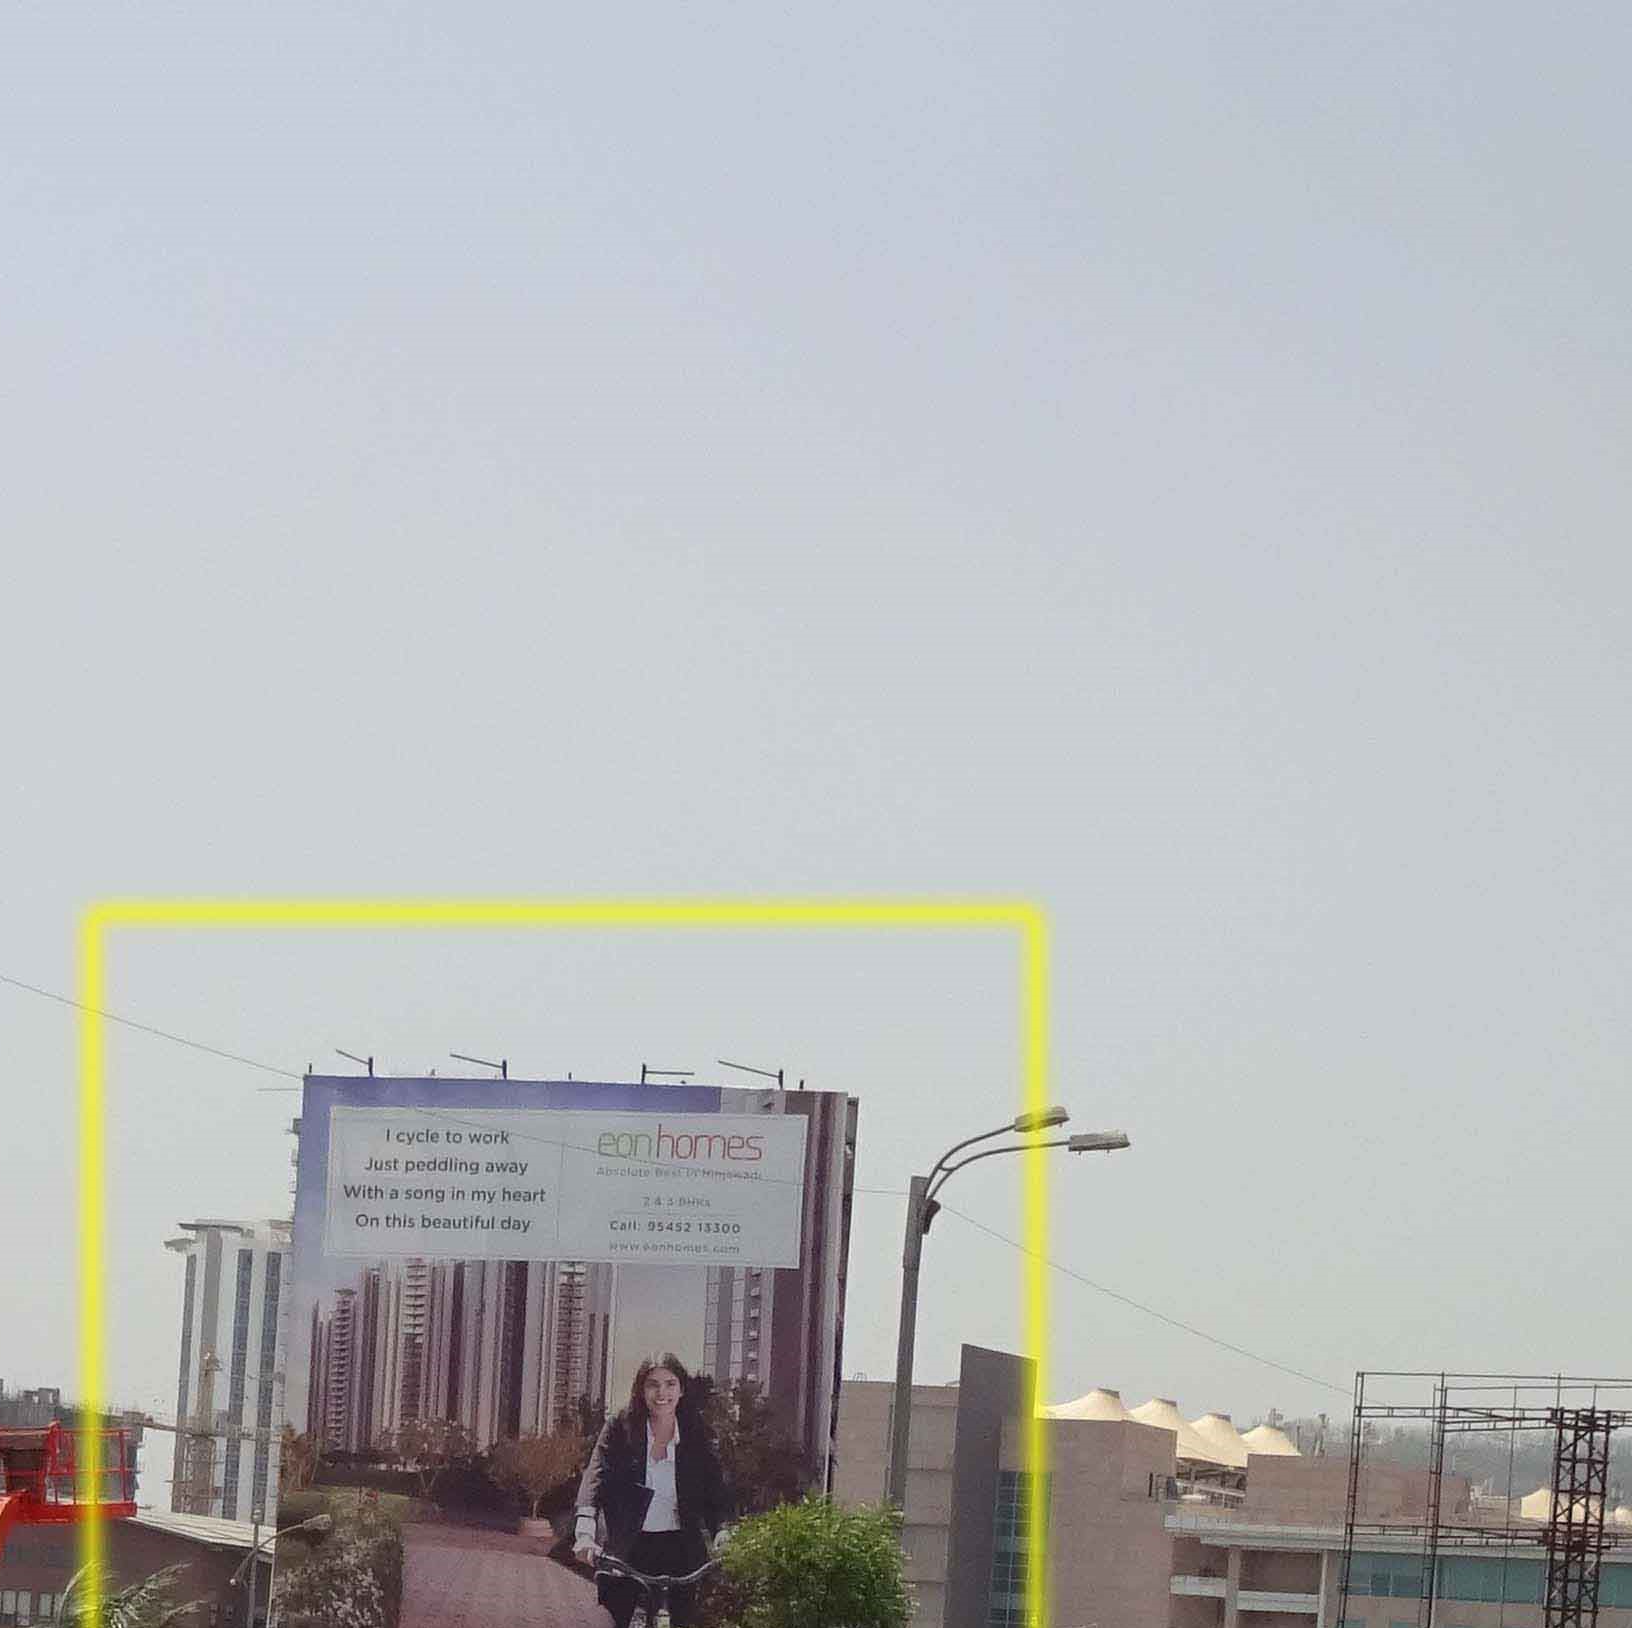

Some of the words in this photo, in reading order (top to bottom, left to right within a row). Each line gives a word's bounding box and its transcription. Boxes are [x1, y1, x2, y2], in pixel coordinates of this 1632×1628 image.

[395, 1128, 440, 1146] cycle
[445, 1129, 463, 1144] to
[468, 1130, 510, 1145] work
[364, 1157, 399, 1172] Just
[404, 1157, 480, 1176] peddling
[484, 1161, 529, 1177] away
[343, 1184, 384, 1200] With
[389, 1187, 399, 1200] a
[404, 1187, 445, 1203] song
[451, 1186, 465, 1201] in
[471, 1188, 496, 1204] my
[502, 1187, 547, 1203] heart
[355, 1213, 380, 1229] On
[385, 1213, 415, 1230] this
[421, 1213, 495, 1231] beautiful
[500, 1216, 531, 1234] day
[609, 1220, 641, 1232] Call:
[647, 1221, 691, 1233] 95452
[697, 1222, 741, 1234] 13300
